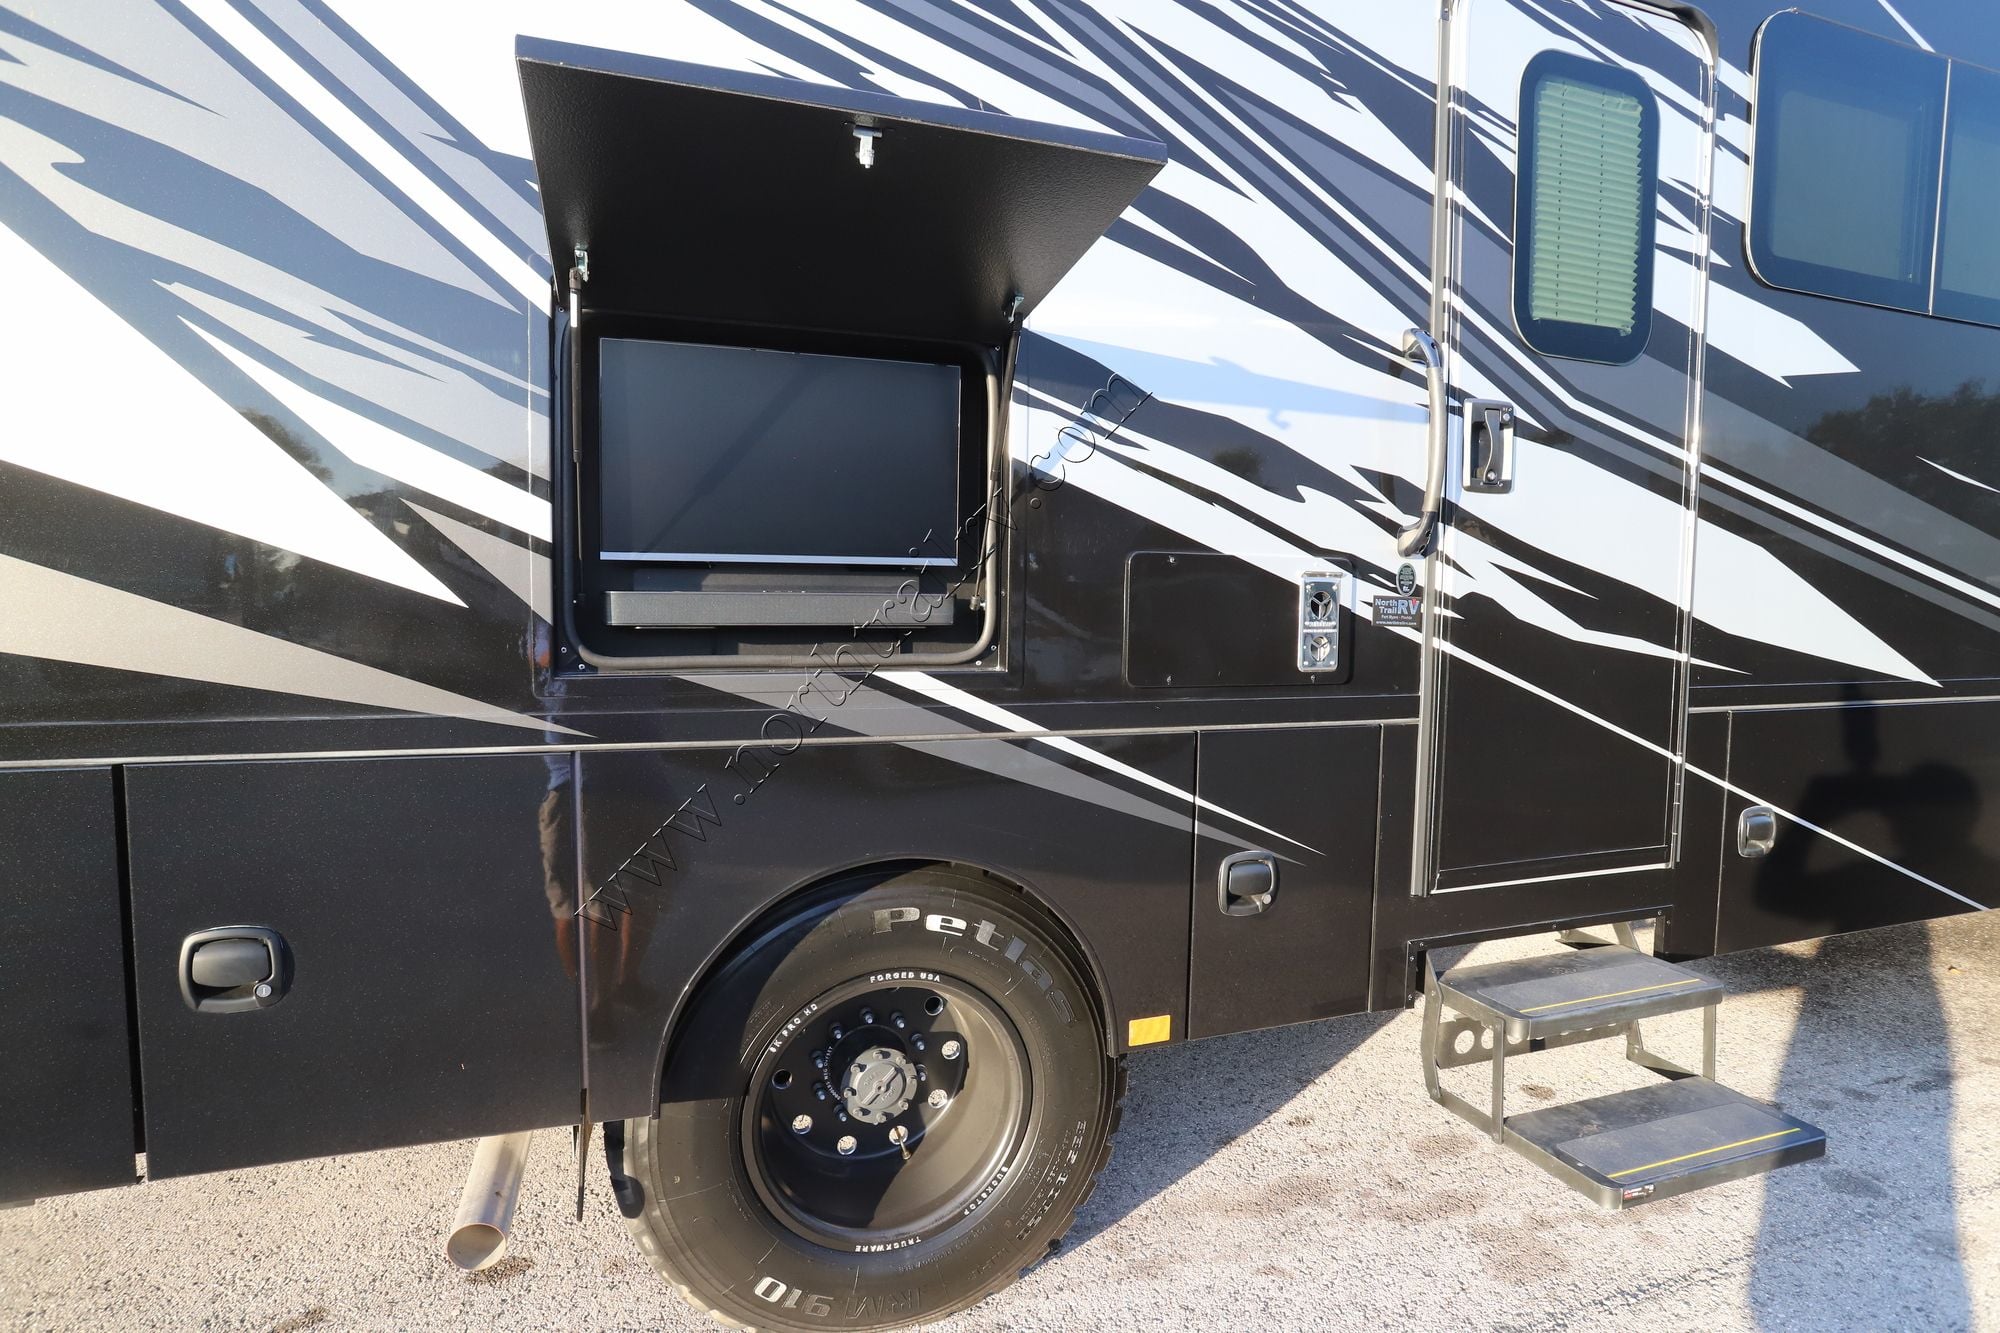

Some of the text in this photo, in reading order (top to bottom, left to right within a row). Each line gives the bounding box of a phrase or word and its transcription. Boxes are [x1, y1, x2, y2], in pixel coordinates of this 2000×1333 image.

[1376, 598, 1397, 607] North
[1379, 606, 1397, 614] Trail
[1398, 598, 1420, 614] RV
[872, 906, 1076, 1024] Petlas
[869, 972, 941, 984] FORGED USA
[782, 1017, 802, 1038] PRO
[803, 1003, 818, 1017] HD
[963, 1166, 1009, 1216] BUCKSTOP
[855, 1236, 922, 1253] TRUCKWARE
[754, 1276, 835, 1317] 910
